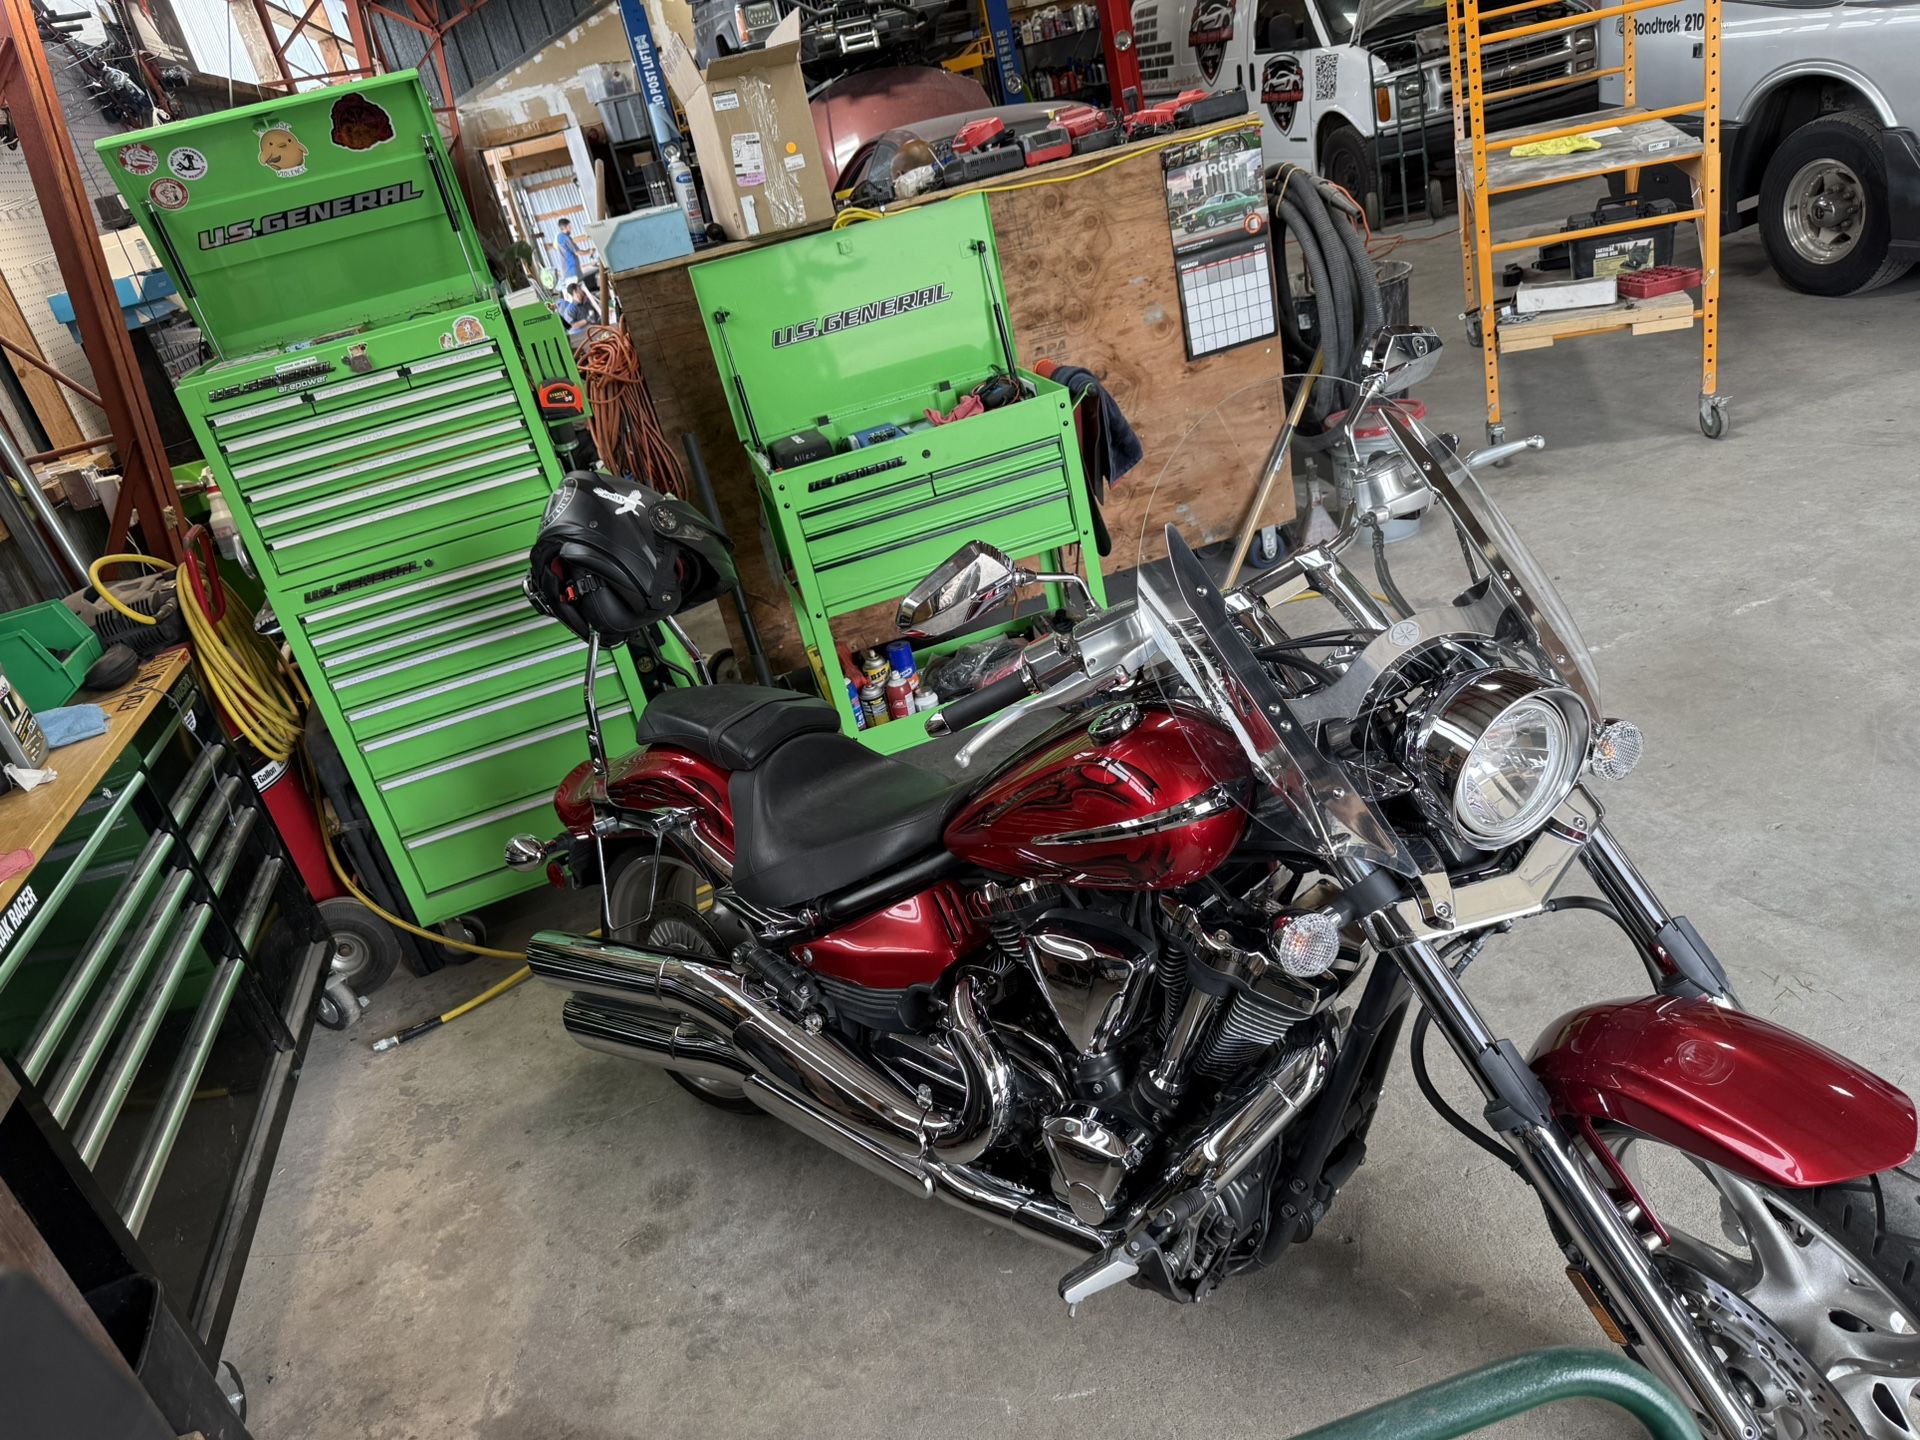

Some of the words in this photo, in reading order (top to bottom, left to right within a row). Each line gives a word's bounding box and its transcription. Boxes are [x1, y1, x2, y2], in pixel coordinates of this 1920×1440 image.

[1684, 13, 1704, 32] 210
[639, 49, 656, 71] LIFT
[644, 70, 662, 95] POST
[1185, 157, 1240, 181] MARCH
[793, 451, 818, 464] Allen
[257, 766, 277, 784] Gallon
[7, 885, 39, 931] RACER
